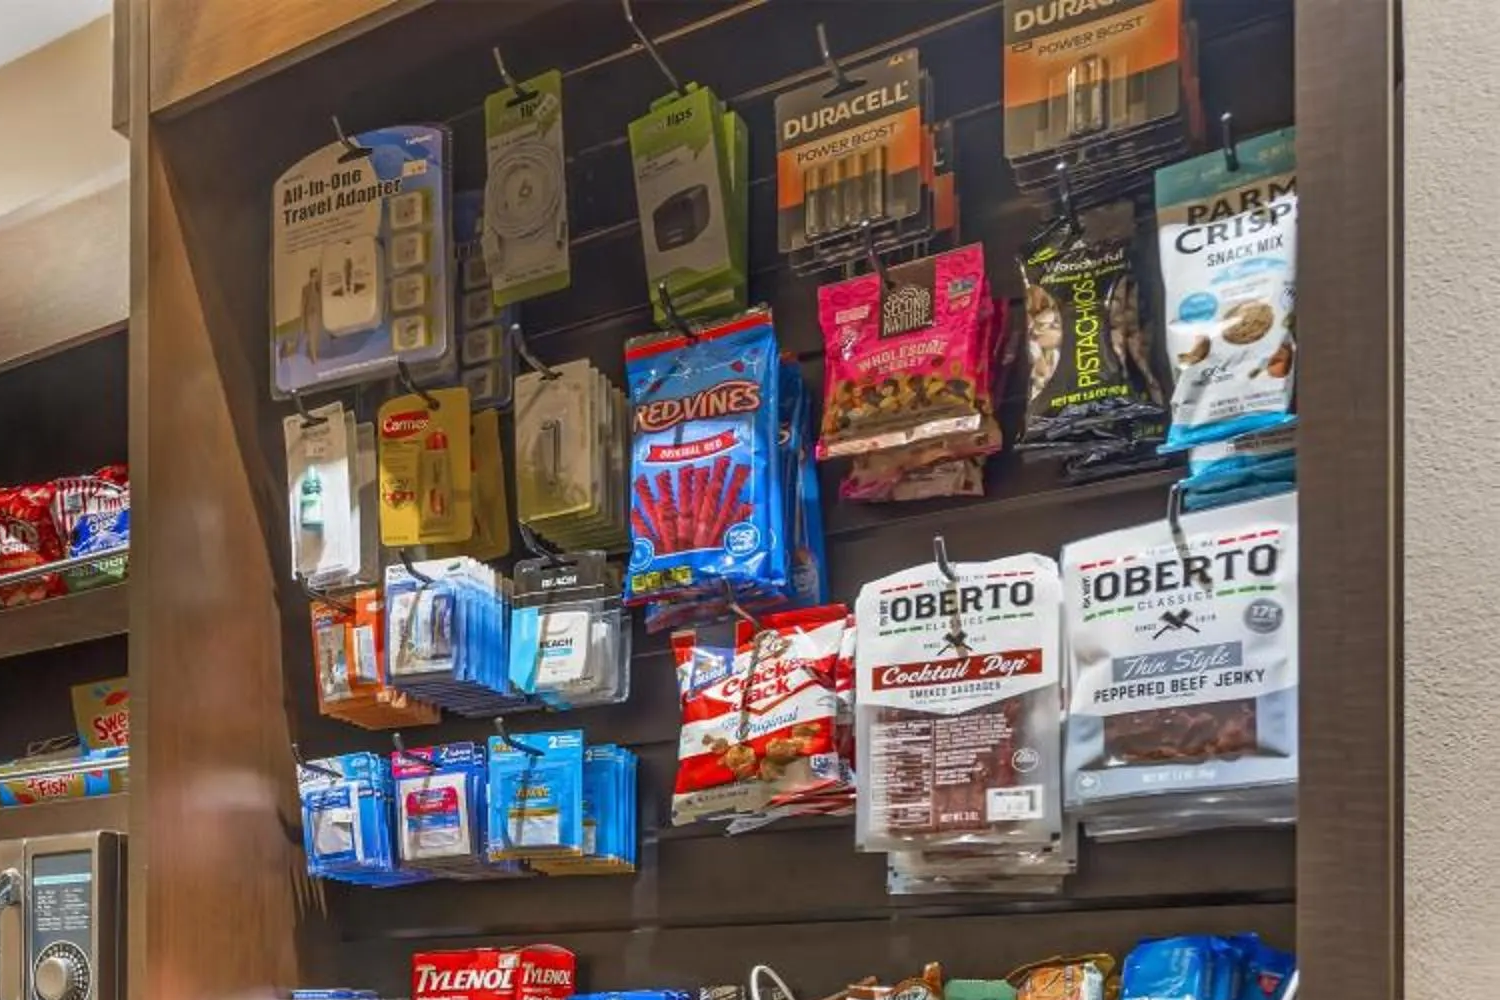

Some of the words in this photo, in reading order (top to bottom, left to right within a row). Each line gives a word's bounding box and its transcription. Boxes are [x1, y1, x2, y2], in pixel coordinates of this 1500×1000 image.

[1038, 31, 1095, 56] POWER
[782, 82, 910, 140] DURACELL
[797, 138, 850, 164] POWER
[851, 122, 899, 147] BOOST
[283, 169, 362, 207] All-In-One
[283, 199, 332, 226] Travel
[336, 179, 402, 211] Adapter
[1187, 175, 1297, 226] PARM
[1206, 245, 1253, 267] SNACK
[1257, 234, 1285, 253] MIX
[883, 291, 932, 319] SECOND
[883, 308, 933, 336] NATURE
[1073, 279, 1100, 388] PISTACHIOS
[857, 338, 950, 371] WHOLESOME
[684, 381, 761, 420] VINES
[383, 418, 429, 433] Carmex
[1093, 543, 1278, 603] OBERTO
[890, 580, 1034, 622] OBERTO
[1137, 590, 1213, 612] CLASSICS
[924, 615, 984, 632] CLAICS
[881, 657, 971, 685] Cocktail
[980, 655, 1029, 677] Pep
[1122, 655, 1167, 680] Thin
[1172, 645, 1230, 674] Style
[1094, 682, 1165, 704] PEPPERED
[1171, 676, 1208, 693] BEEF
[1214, 669, 1266, 688] JERKY
[415, 963, 516, 993] TYLENOL
[521, 961, 572, 986] TYLENOL
